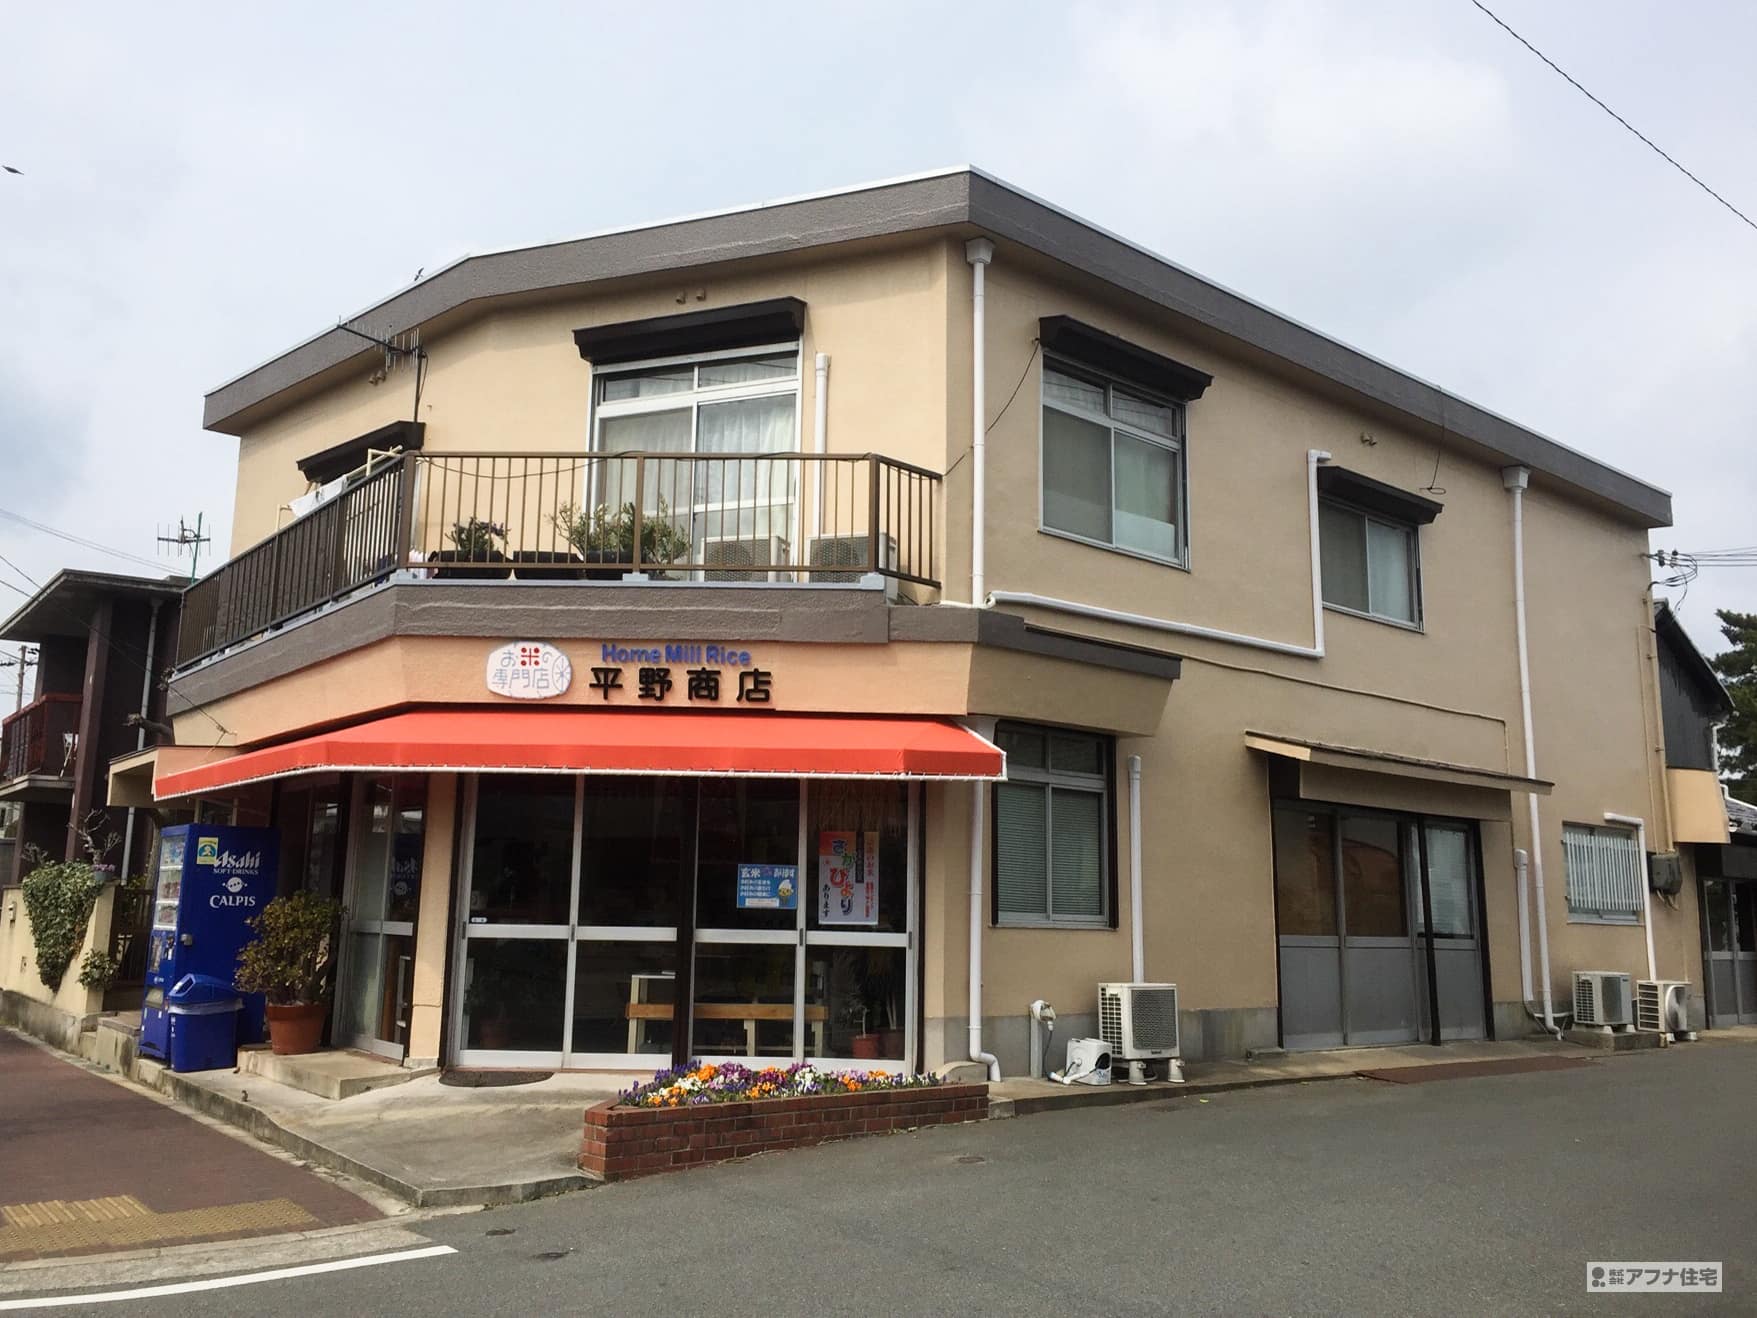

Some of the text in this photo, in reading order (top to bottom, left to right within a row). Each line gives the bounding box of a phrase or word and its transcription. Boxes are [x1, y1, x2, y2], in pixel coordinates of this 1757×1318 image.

[500, 647, 552, 667] お米の
[601, 643, 752, 666] Home Mill Rice
[491, 668, 550, 689] 専門店
[588, 666, 772, 703] 平野商店
[213, 850, 261, 869] Asahi
[209, 894, 256, 909] CALPIS
